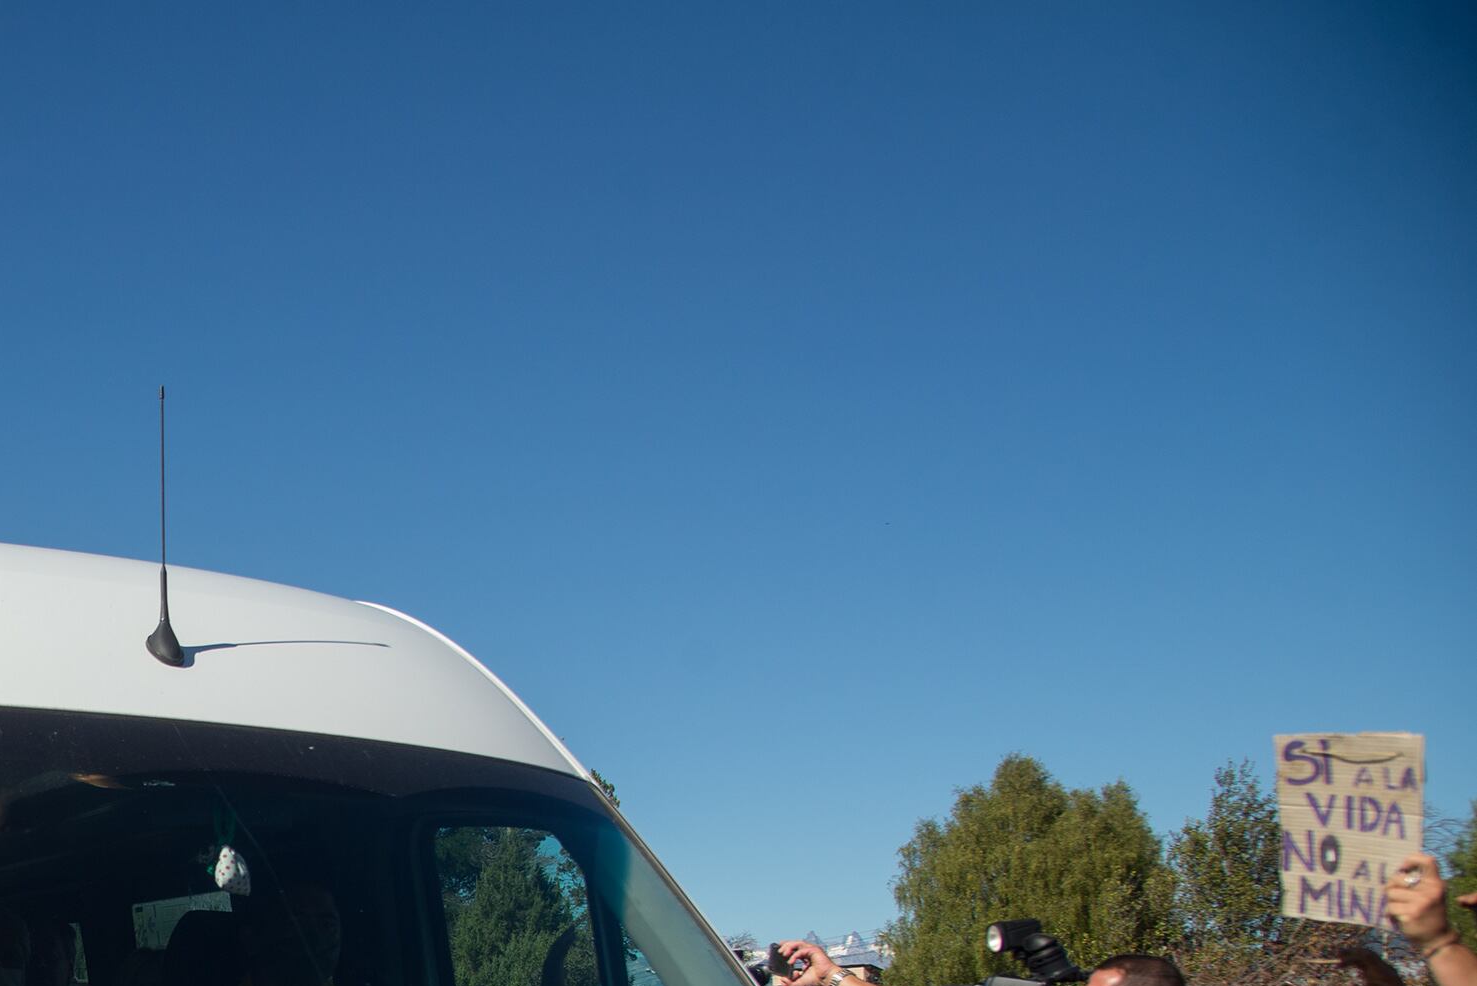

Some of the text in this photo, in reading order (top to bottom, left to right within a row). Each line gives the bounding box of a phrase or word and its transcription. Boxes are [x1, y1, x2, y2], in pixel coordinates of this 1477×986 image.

[1354, 767, 1373, 788] A
[1381, 767, 1417, 791] LA
[1305, 792, 1405, 840] VIDA
[1282, 829, 1342, 875] NO
